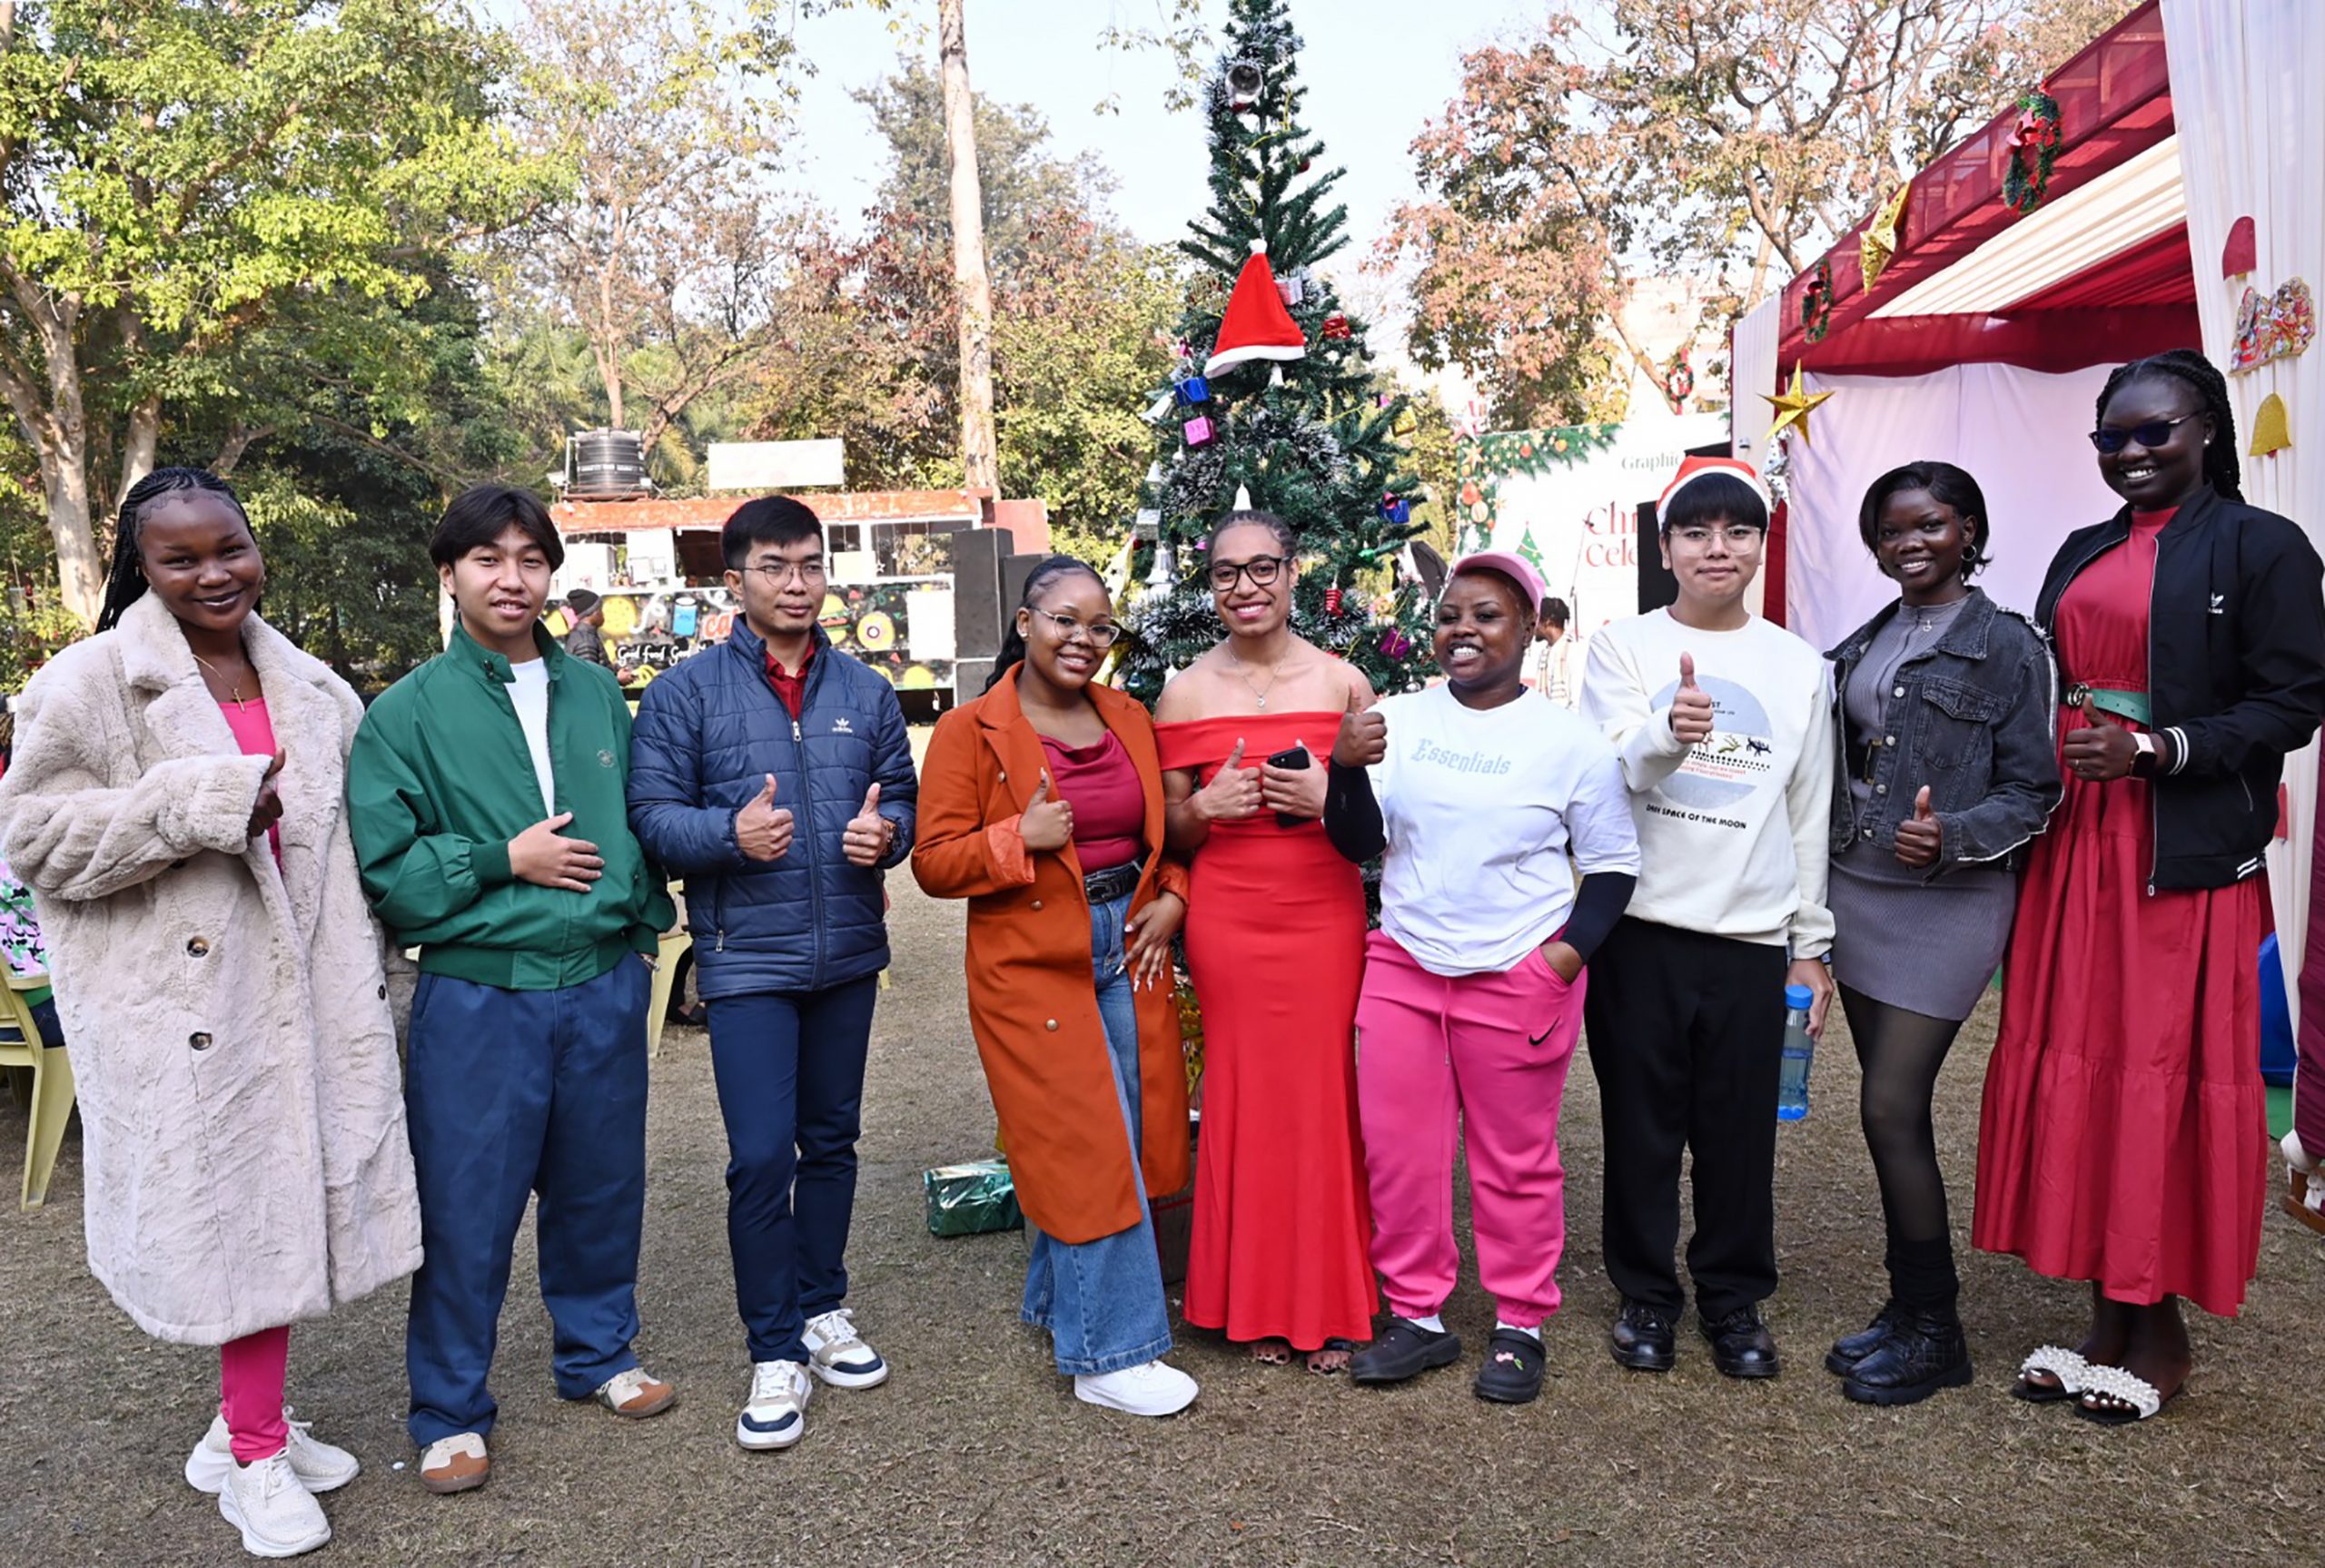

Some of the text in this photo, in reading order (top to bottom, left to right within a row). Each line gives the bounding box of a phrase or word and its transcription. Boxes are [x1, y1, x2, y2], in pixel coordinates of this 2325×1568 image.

[1662, 807, 1686, 819] SPACE
[1687, 813, 1700, 822] OF
[1701, 814, 1717, 824] THE
[1718, 818, 1747, 830] MOON
